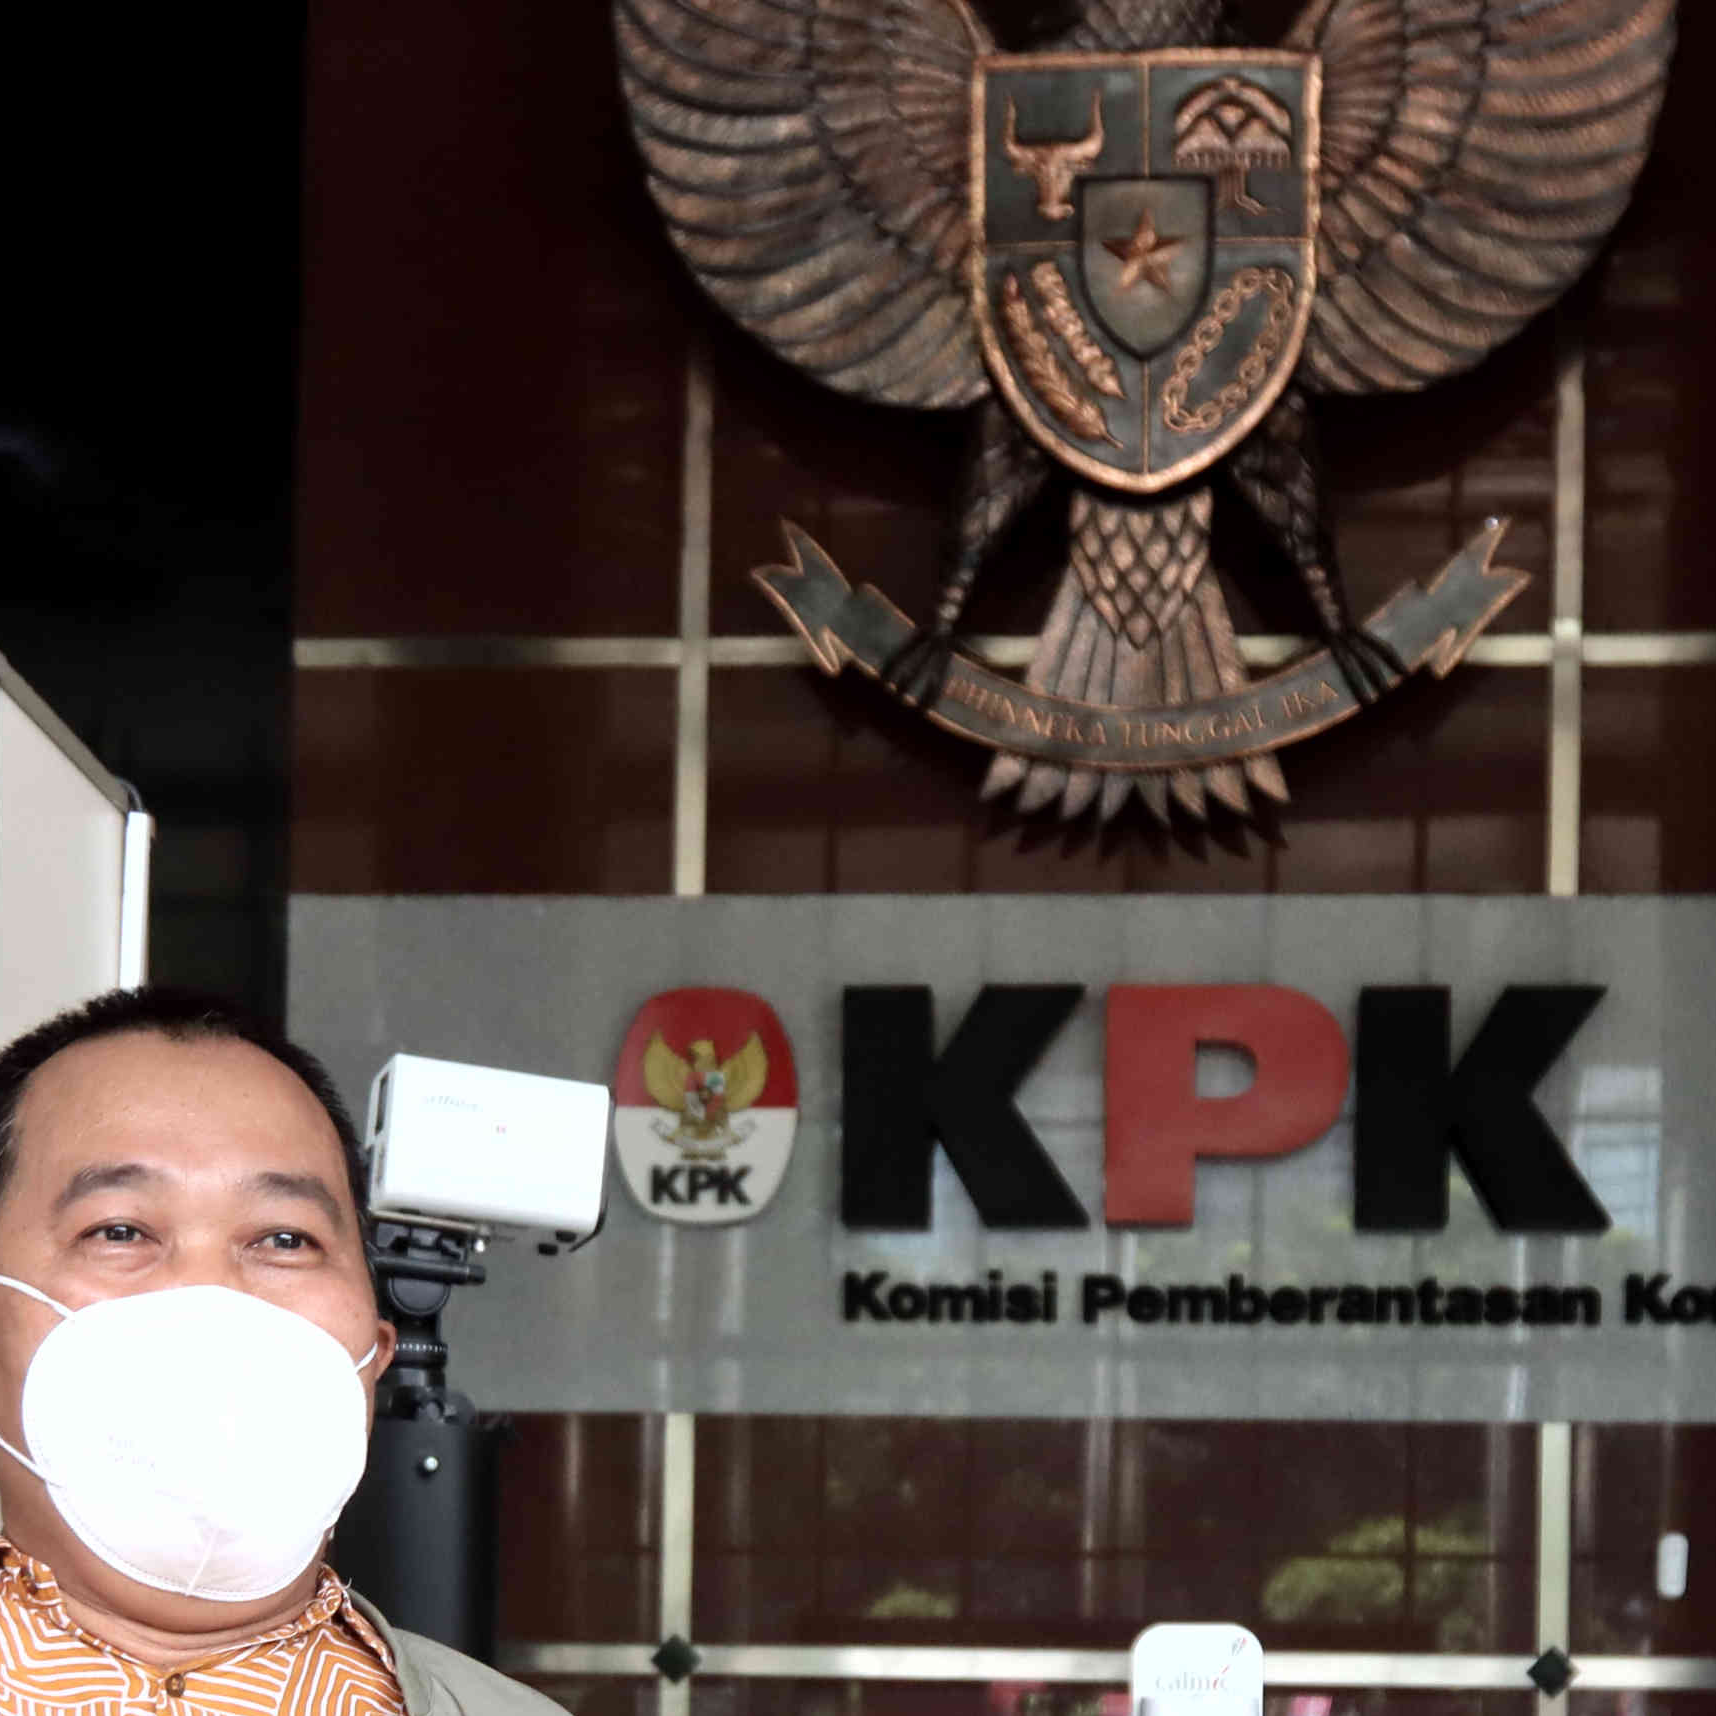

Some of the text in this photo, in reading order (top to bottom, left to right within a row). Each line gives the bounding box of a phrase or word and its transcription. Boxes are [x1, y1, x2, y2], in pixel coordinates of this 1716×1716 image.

[1120, 702, 1266, 747] TUNGGAL
[1281, 680, 1340, 719] IKA
[842, 984, 1613, 1234] KPK
[651, 1164, 752, 1207] KPK
[842, 1270, 1059, 1324] Komisi
[1083, 1272, 1603, 1326] Pemberantasan
